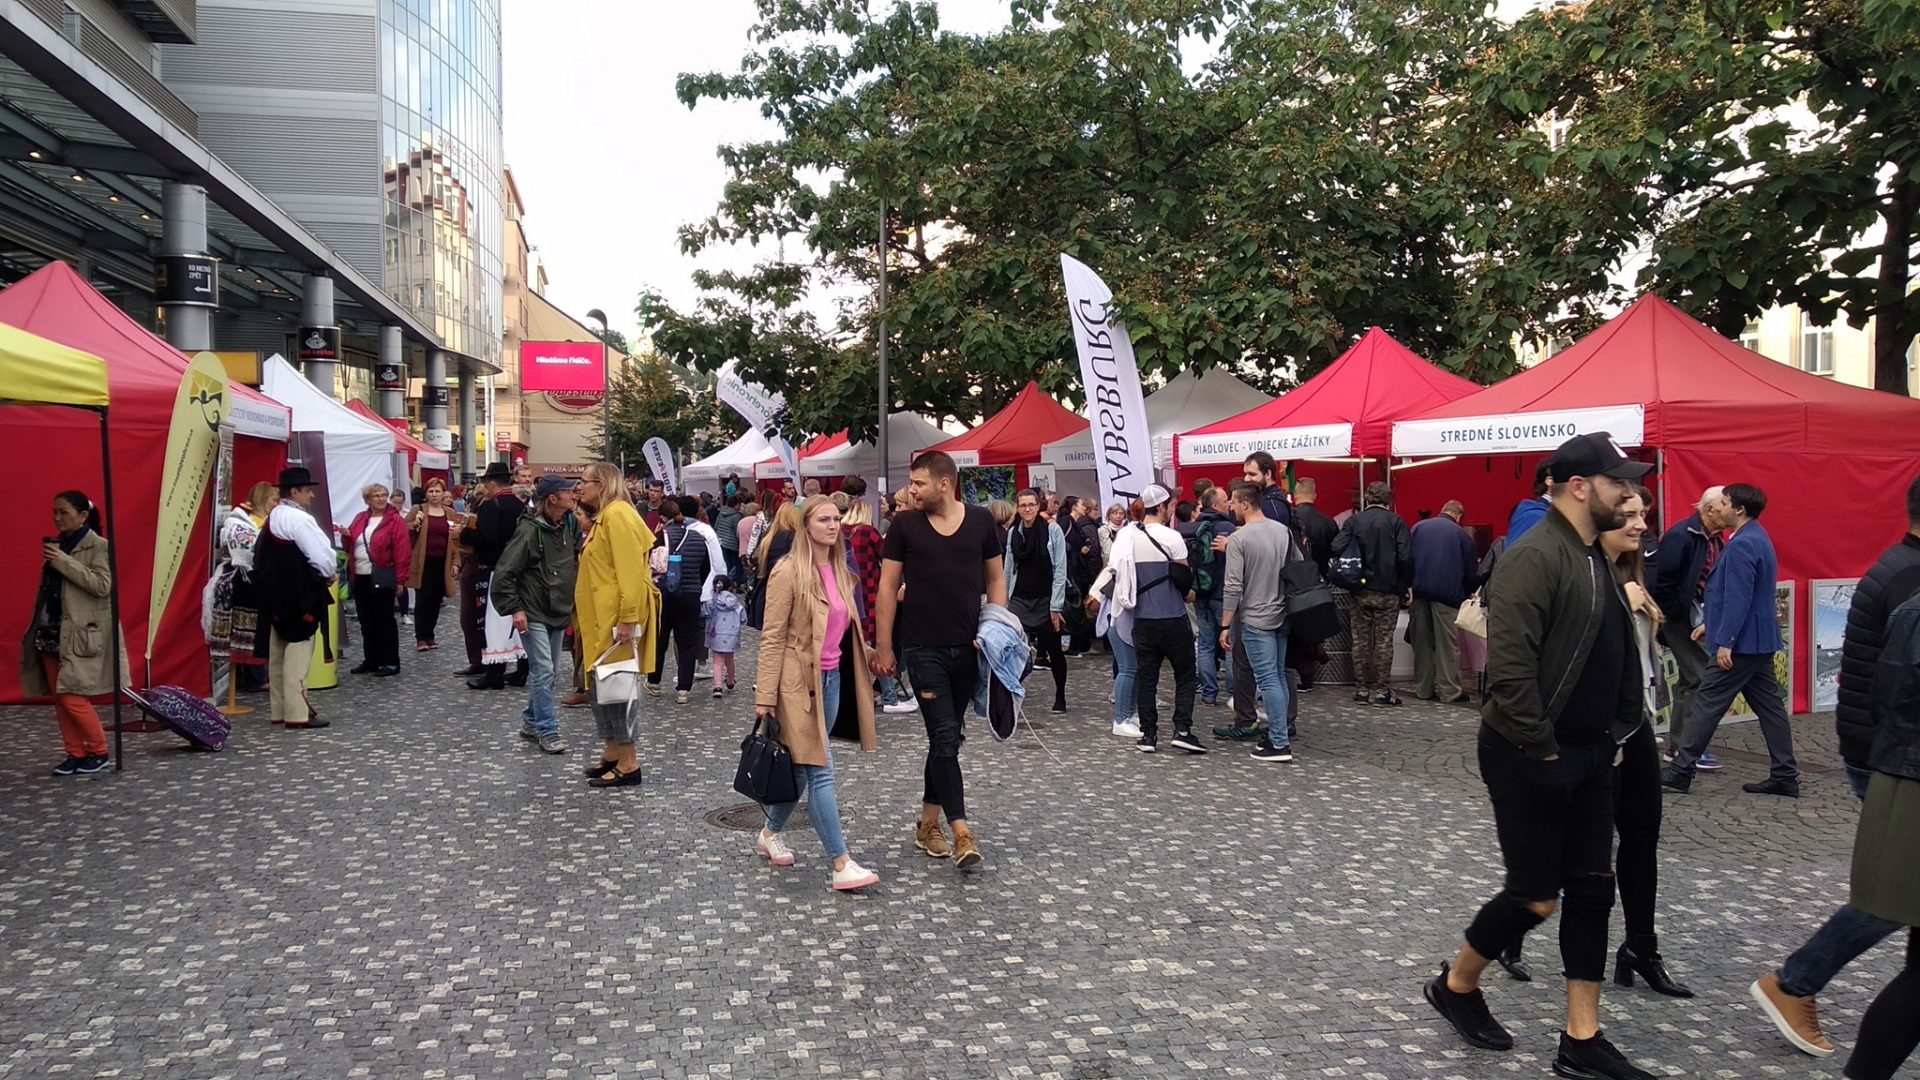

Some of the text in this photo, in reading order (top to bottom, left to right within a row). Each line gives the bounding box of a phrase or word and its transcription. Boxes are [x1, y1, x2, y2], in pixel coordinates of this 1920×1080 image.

[1440, 423, 1577, 443] STREDNÉ SLOVENSKO
[1193, 442, 1239, 455] HIADLOVEC
[1248, 438, 1288, 452] VIDIECKE
[1291, 435, 1331, 448] ZÁŽITKY
